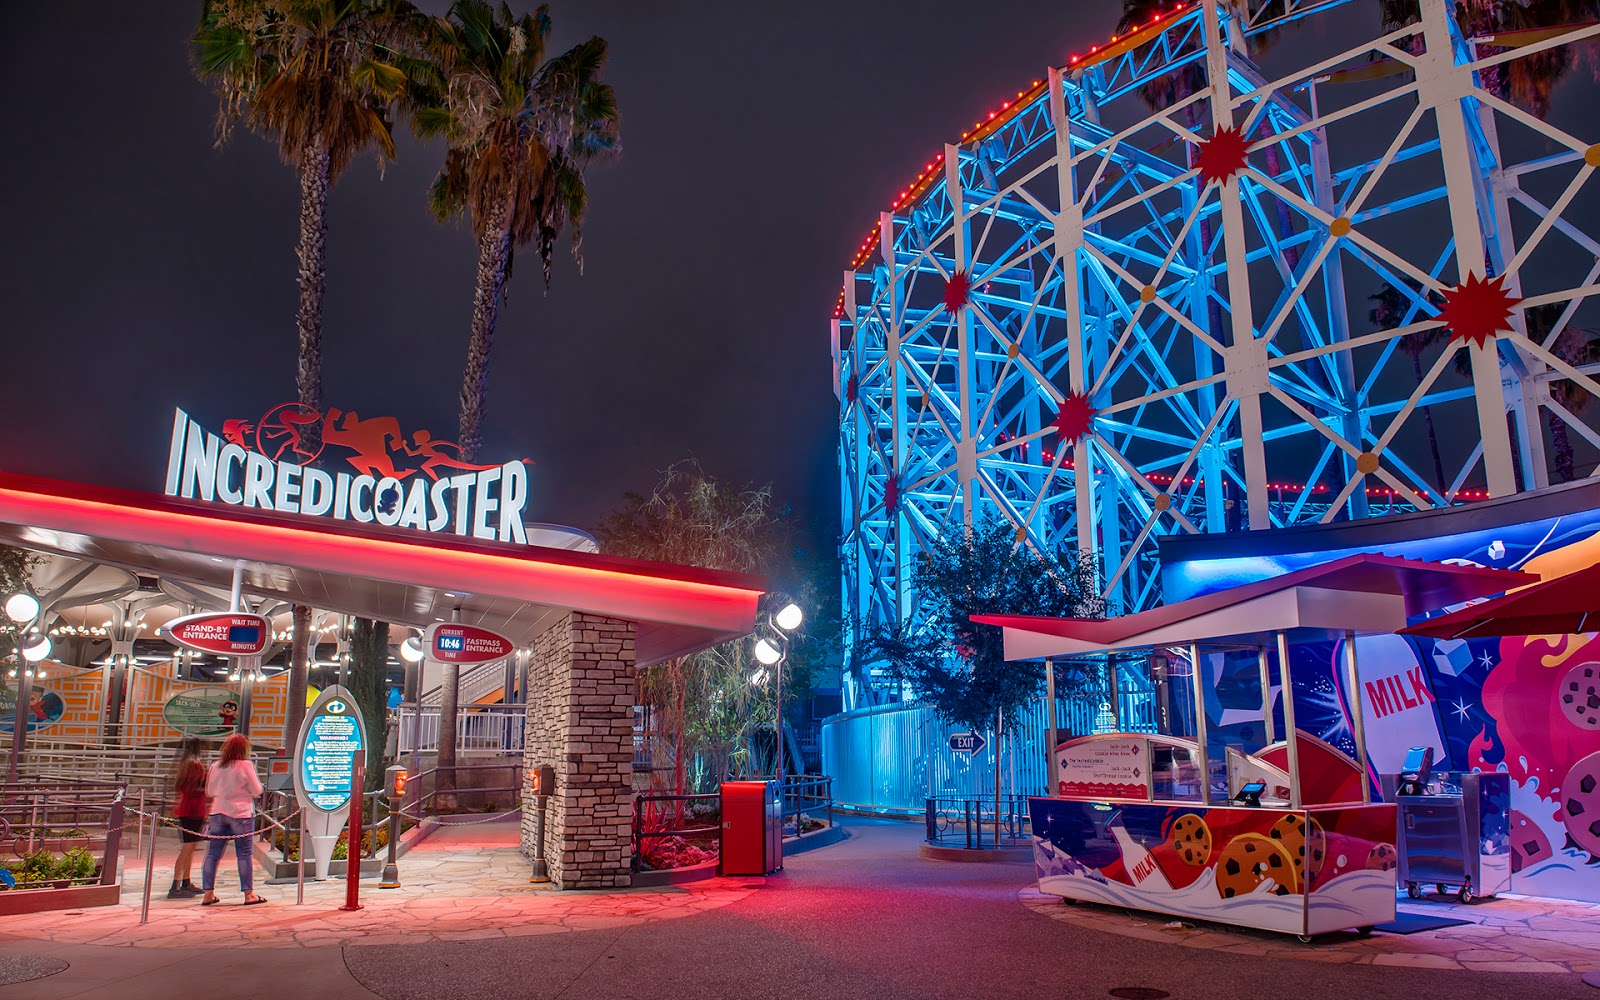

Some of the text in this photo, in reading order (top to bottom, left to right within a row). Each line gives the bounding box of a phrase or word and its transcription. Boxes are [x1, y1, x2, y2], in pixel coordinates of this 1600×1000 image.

[165, 406, 528, 545] INCREDICOASTER
[231, 618, 261, 627] WAIT TIME
[184, 624, 229, 633] STAND-BY
[440, 628, 464, 636] CURRENT
[182, 631, 228, 641] ENTRANCE
[230, 643, 257, 651] MINUTES
[440, 638, 460, 649] 10:46
[466, 638, 501, 647] FASTPASS
[465, 645, 504, 654] ENTRANCE
[444, 651, 457, 659] TIME
[1364, 665, 1436, 719] MILK
[957, 737, 975, 748] EXIT
[1131, 853, 1157, 884] MILK
